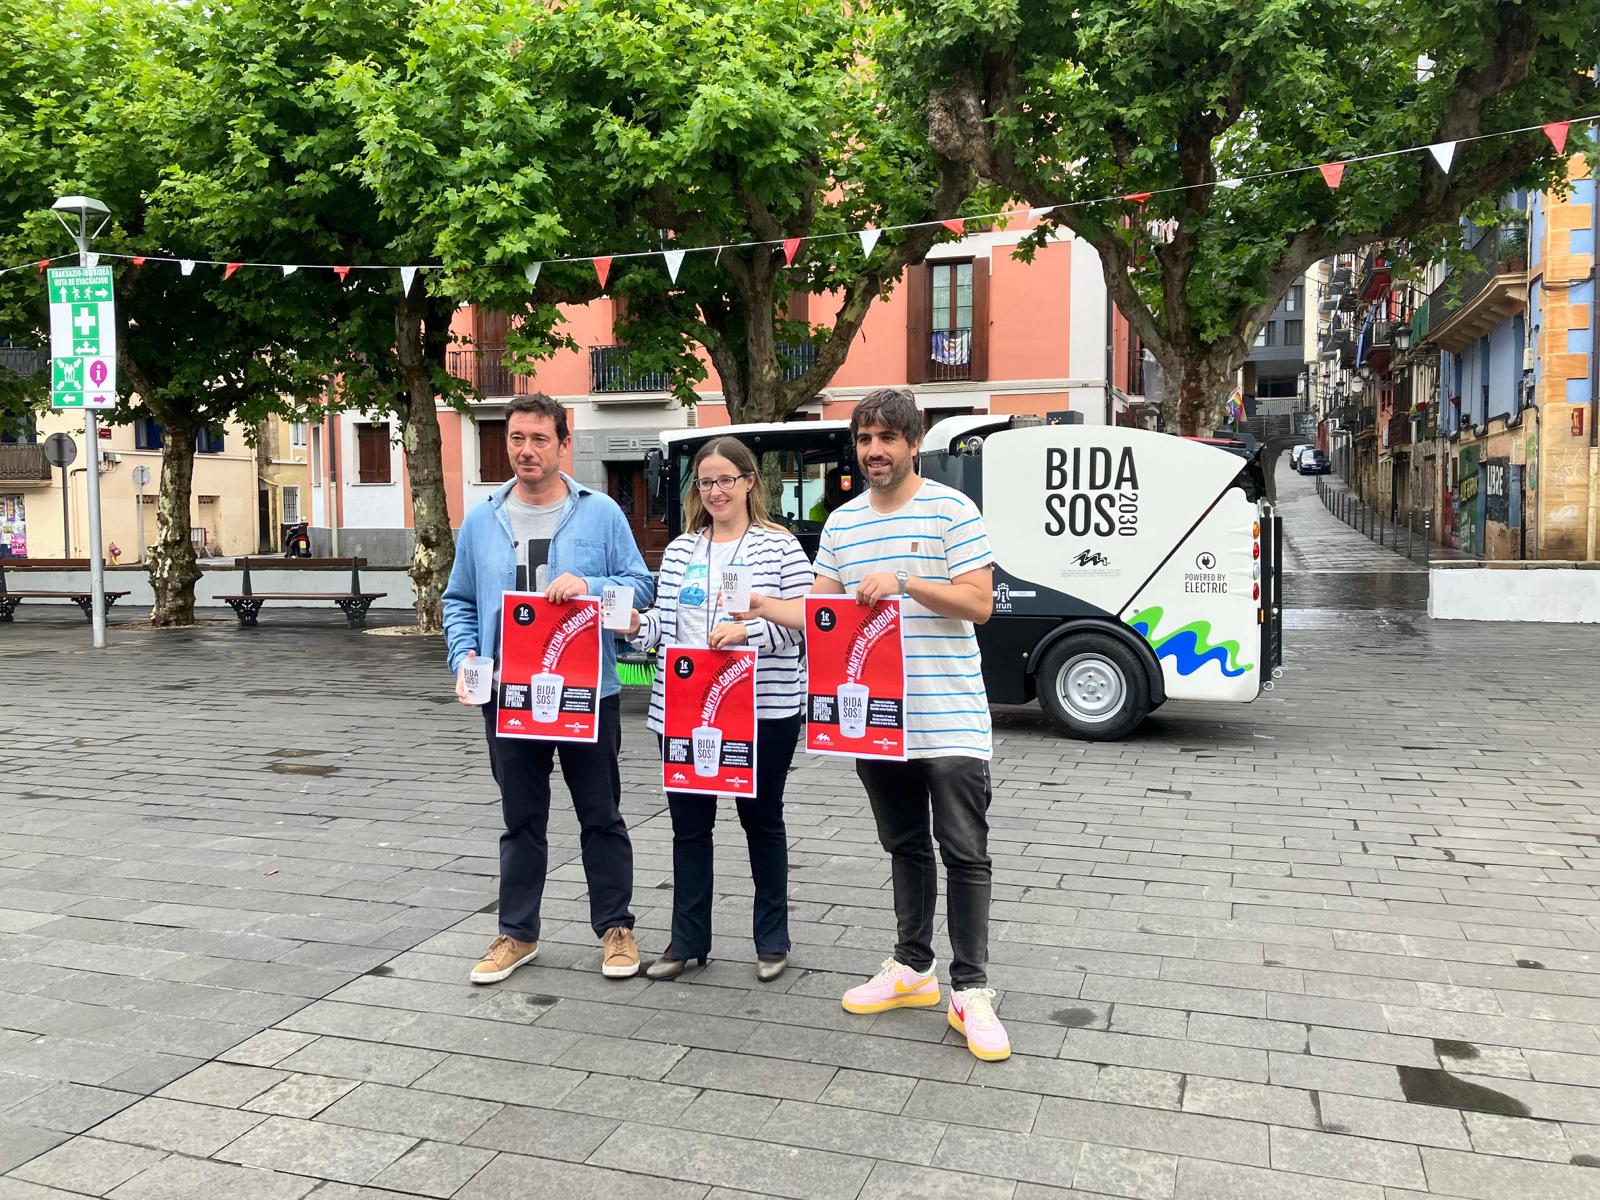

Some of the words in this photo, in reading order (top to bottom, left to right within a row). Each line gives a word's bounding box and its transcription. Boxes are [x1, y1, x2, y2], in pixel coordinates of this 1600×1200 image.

[1046, 446, 1139, 490] BIDA
[1045, 493, 1116, 537] SOS
[1118, 493, 1138, 536] 2030
[1185, 573, 1215, 581] POWERED
[1217, 573, 1226, 581] BY
[1185, 582, 1228, 593] ELECTRIC
[541, 630, 566, 667] MARTZIAL
[562, 604, 598, 634] GARBIAK
[846, 636, 867, 676] MARTZIAL
[864, 604, 899, 639] GARBIAK
[536, 686, 556, 695] BIDA
[701, 683, 722, 720] MARTZIAL
[718, 654, 754, 686] GARBIAK
[536, 695, 551, 704] SOS
[843, 696, 862, 707] BIDA
[844, 707, 858, 718] SOS
[698, 739, 716, 749] BIDA
[698, 749, 712, 758] SOS
